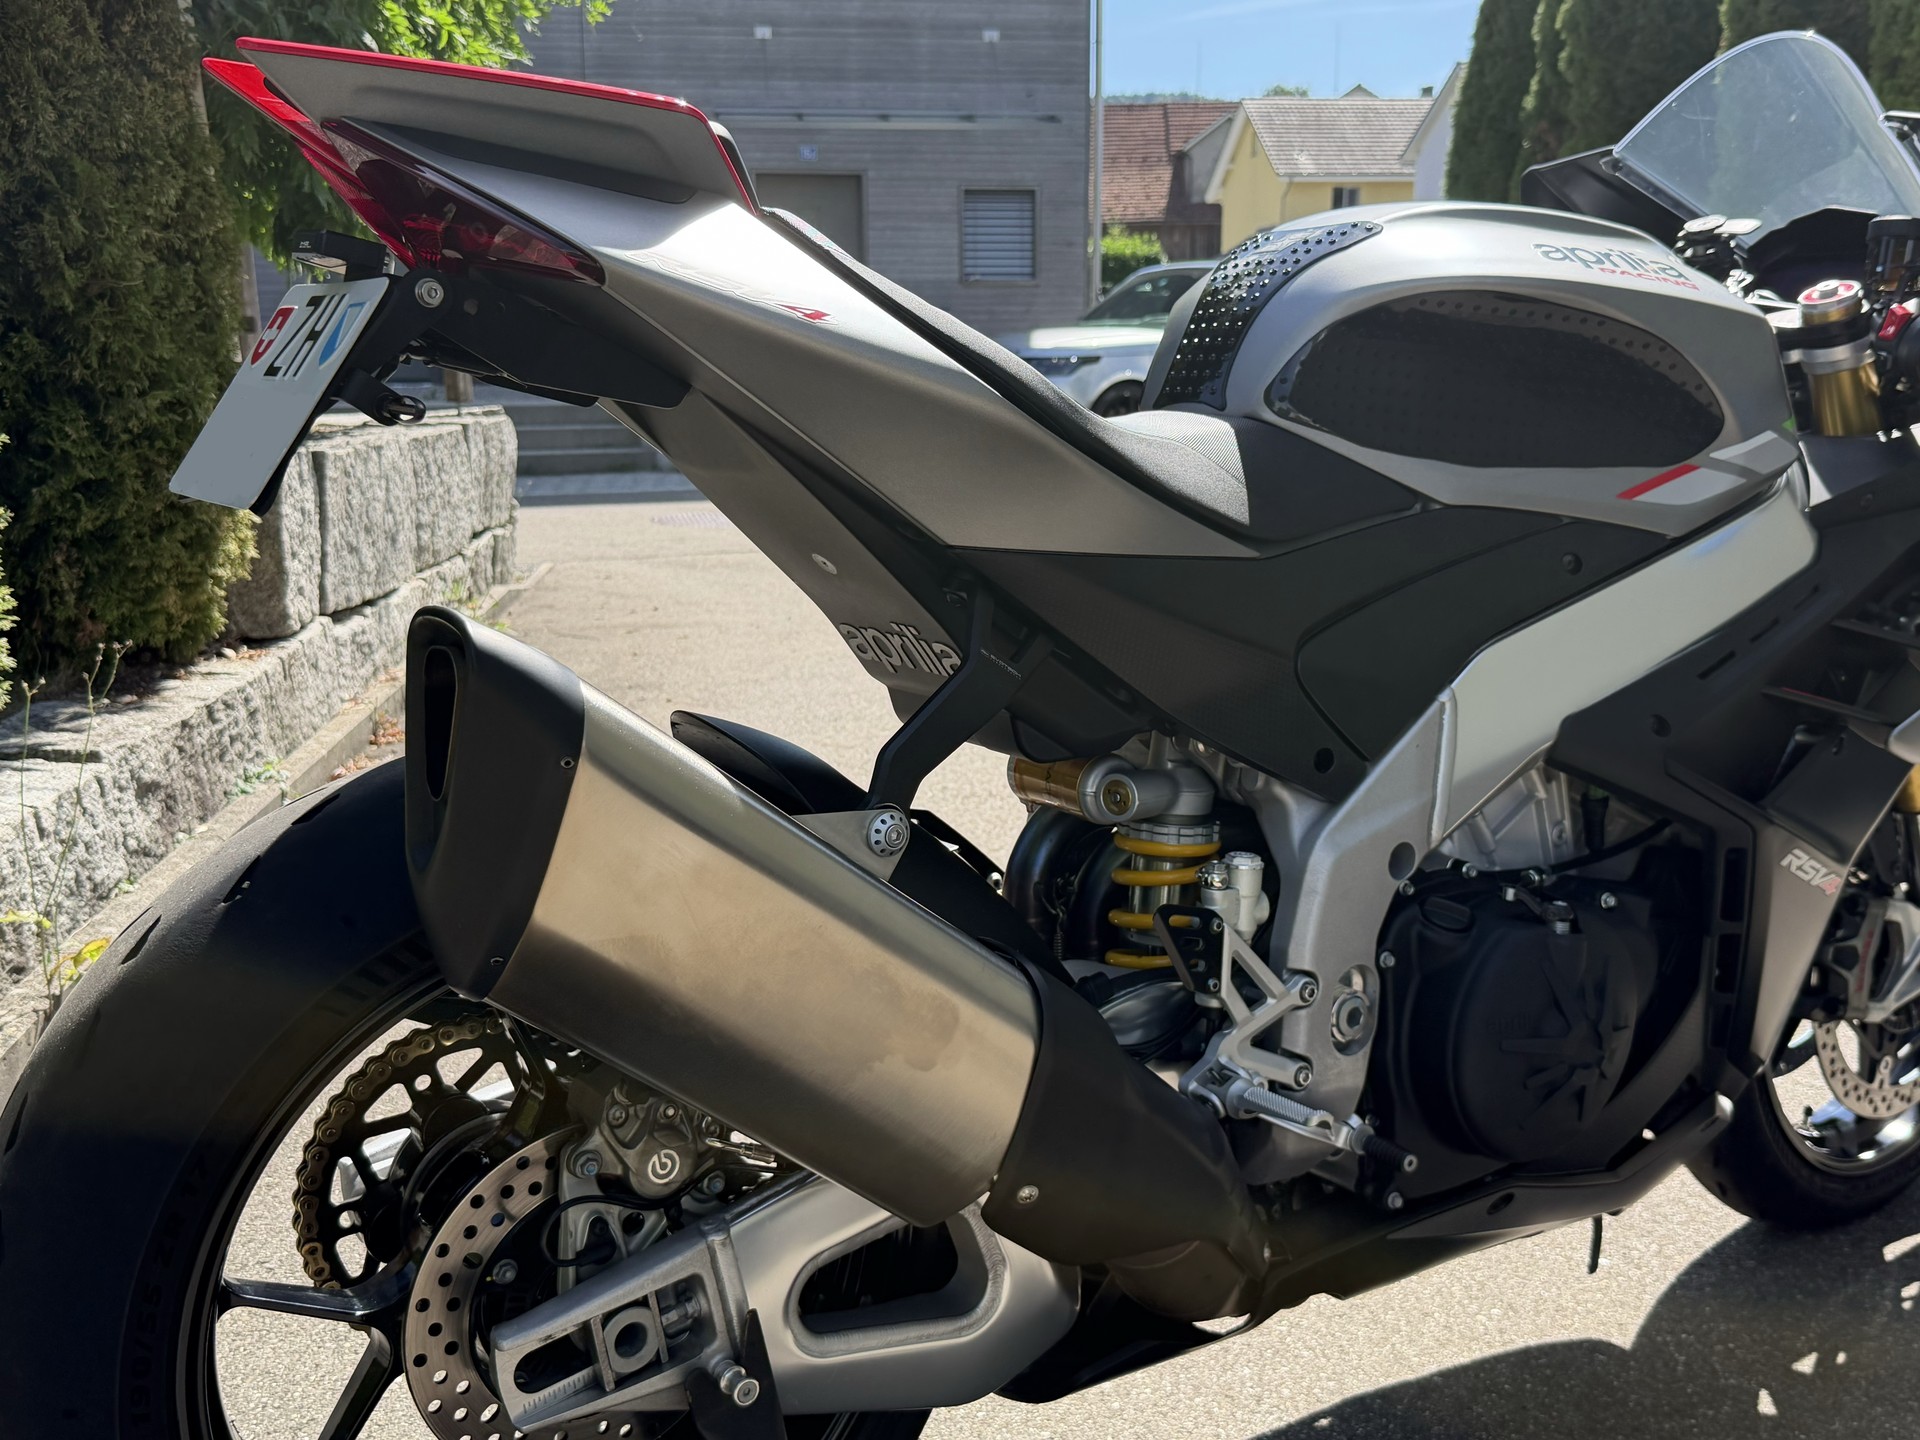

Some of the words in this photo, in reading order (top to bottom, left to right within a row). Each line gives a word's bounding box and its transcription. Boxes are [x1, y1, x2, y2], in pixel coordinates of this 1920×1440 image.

[1531, 243, 1692, 282] aprilia
[1599, 267, 1699, 290] RACING
[263, 293, 349, 378] ZH
[839, 621, 962, 678] aprilia
[1779, 848, 1842, 896] RSV4
[128, 1282, 163, 1428] 190/55
